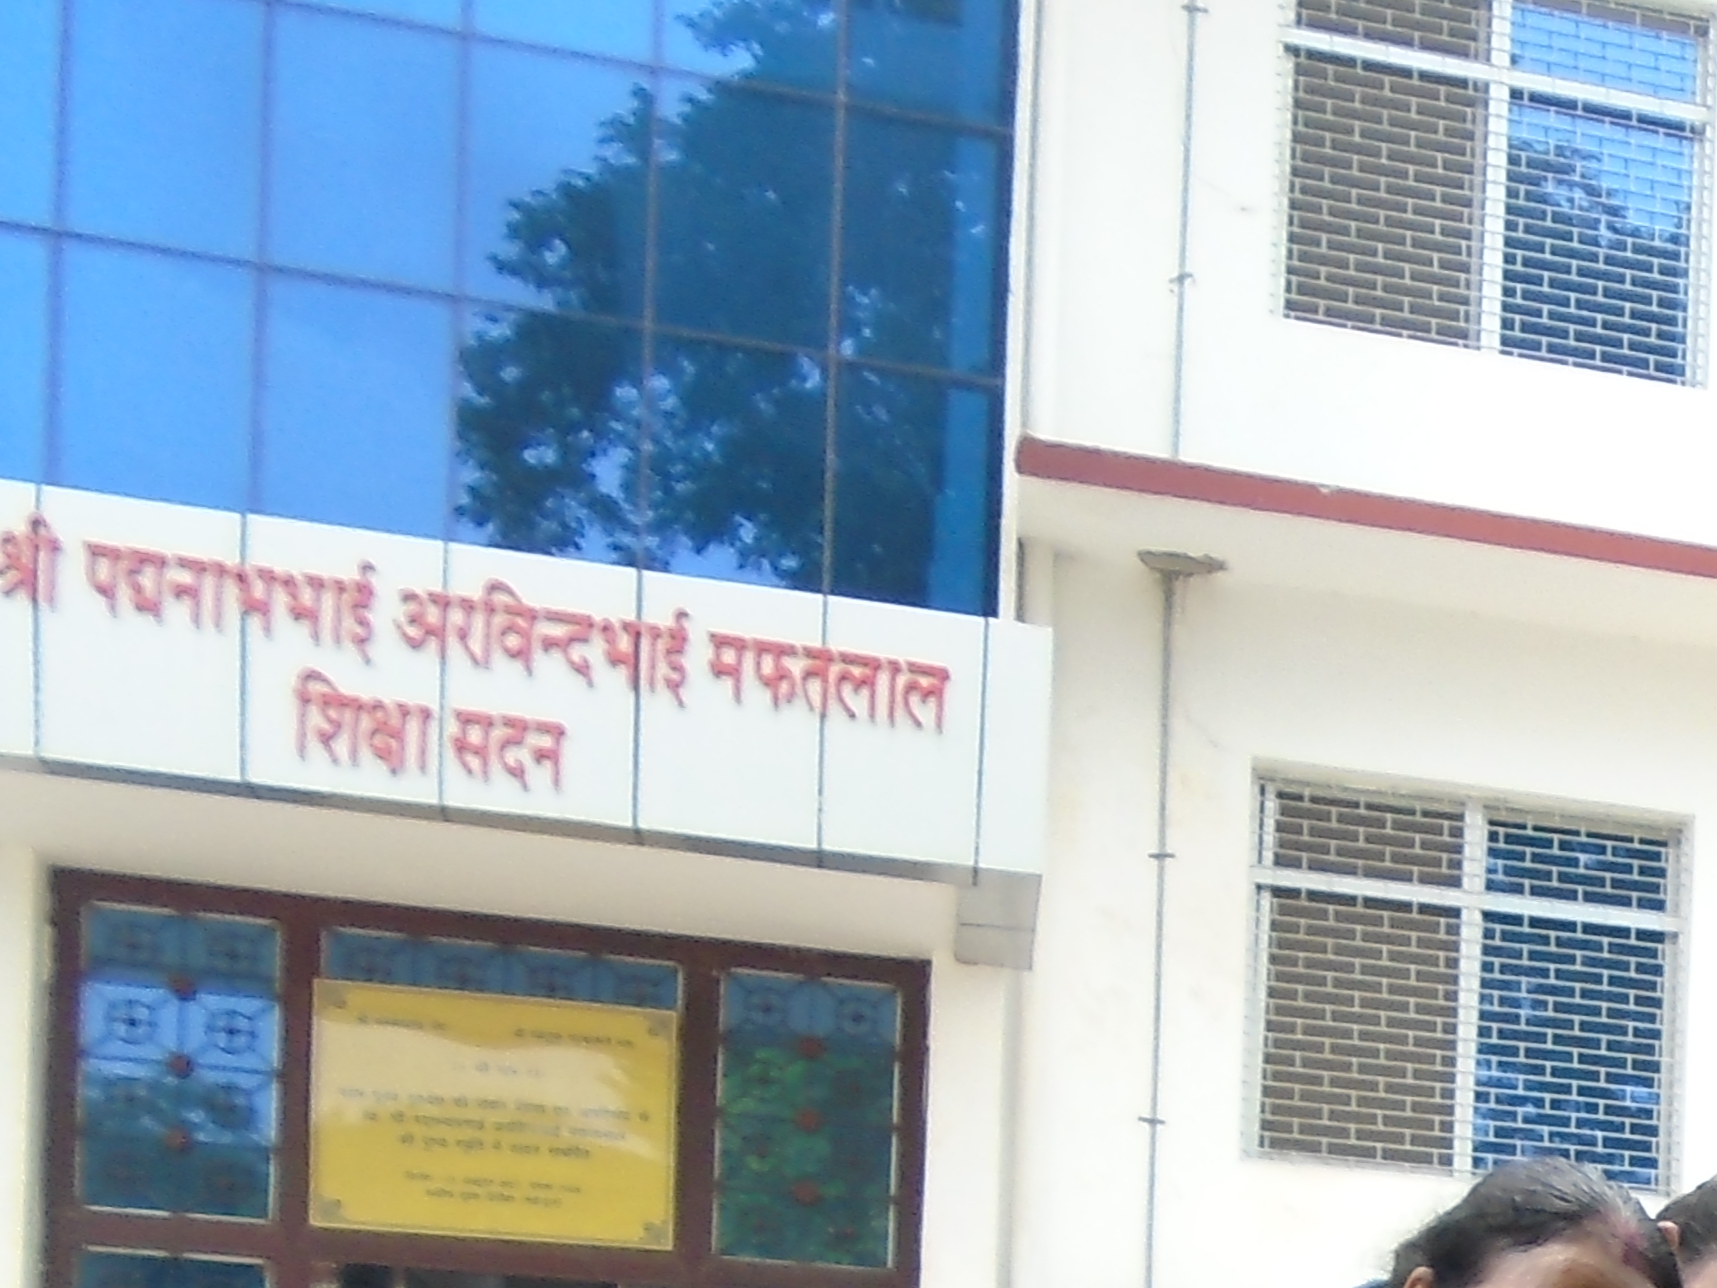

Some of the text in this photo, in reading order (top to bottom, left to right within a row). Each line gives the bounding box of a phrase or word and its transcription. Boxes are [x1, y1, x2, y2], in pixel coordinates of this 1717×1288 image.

[0, 511, 62, 614] श्री
[393, 576, 690, 708] अरविन्दभाई
[707, 629, 952, 735] मफतलाल
[295, 666, 568, 793] शिक्षा सदन
